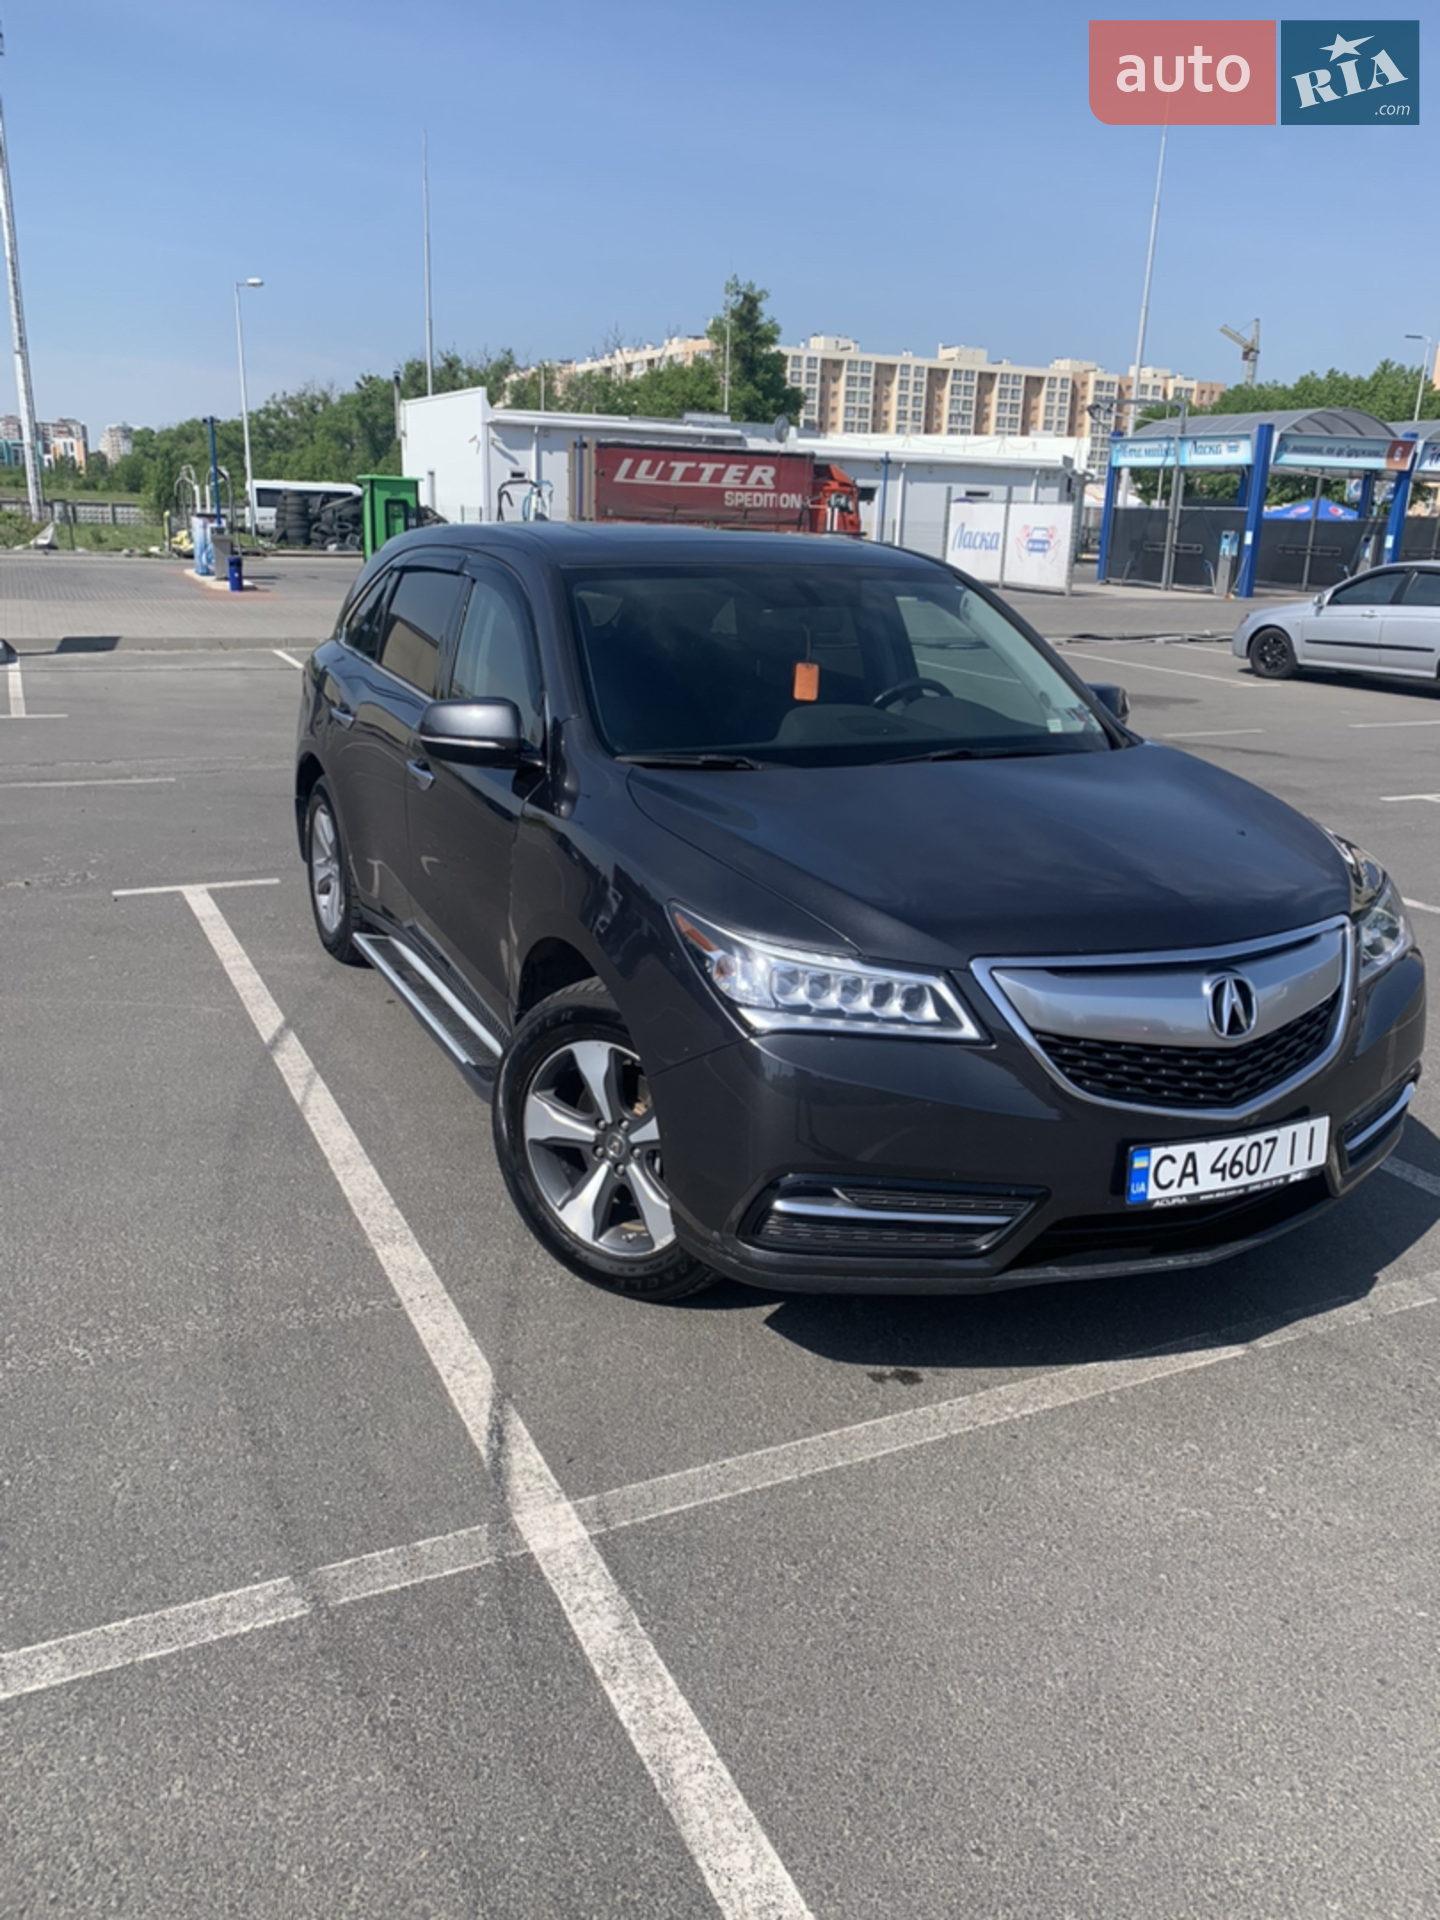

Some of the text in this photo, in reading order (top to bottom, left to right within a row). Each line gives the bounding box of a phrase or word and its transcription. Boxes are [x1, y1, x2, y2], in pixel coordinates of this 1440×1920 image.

[613, 457, 776, 489] LUTTER
[724, 490, 802, 509] SPEDITION
[952, 522, 1000, 552] Ласка
[1152, 1151, 1199, 1191] CA
[1210, 1136, 1278, 1182] 4607
[1130, 1181, 1146, 1194] UA
